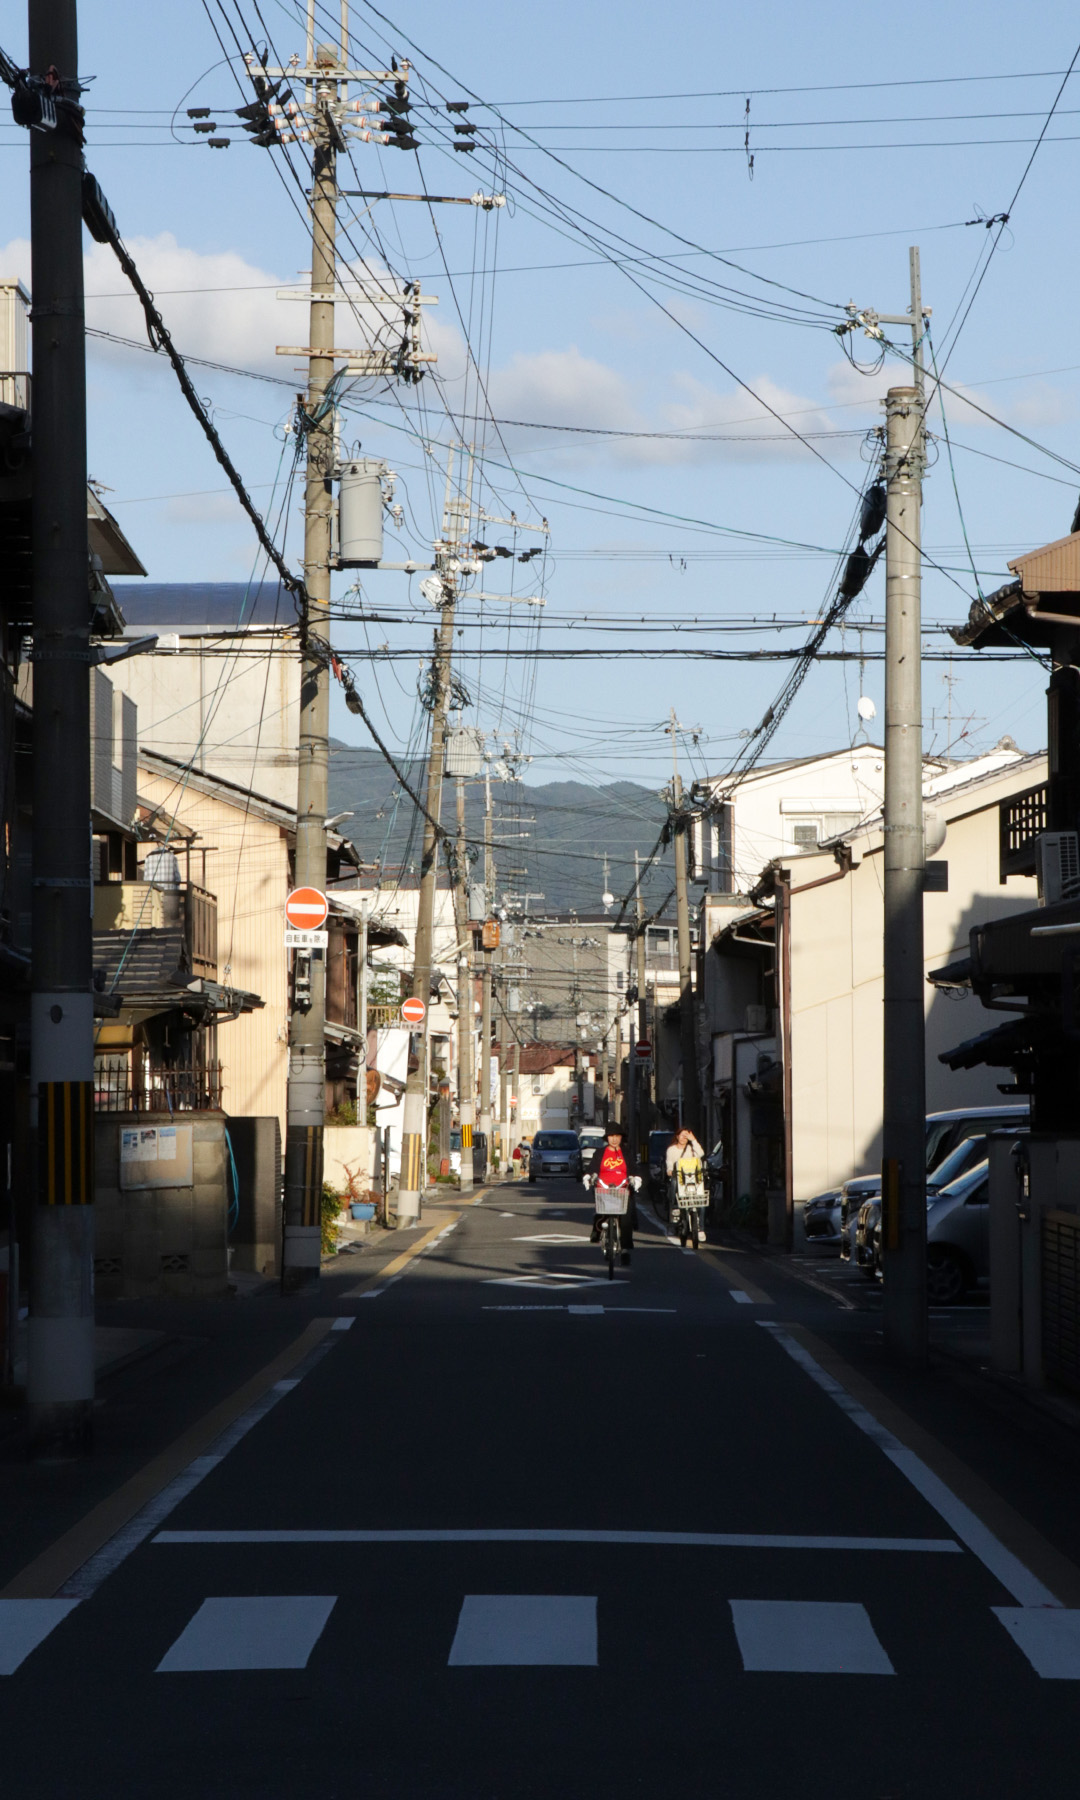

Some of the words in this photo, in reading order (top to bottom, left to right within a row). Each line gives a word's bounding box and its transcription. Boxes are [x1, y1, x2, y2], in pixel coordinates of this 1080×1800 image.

[286, 934, 326, 944] 自転車を除く
